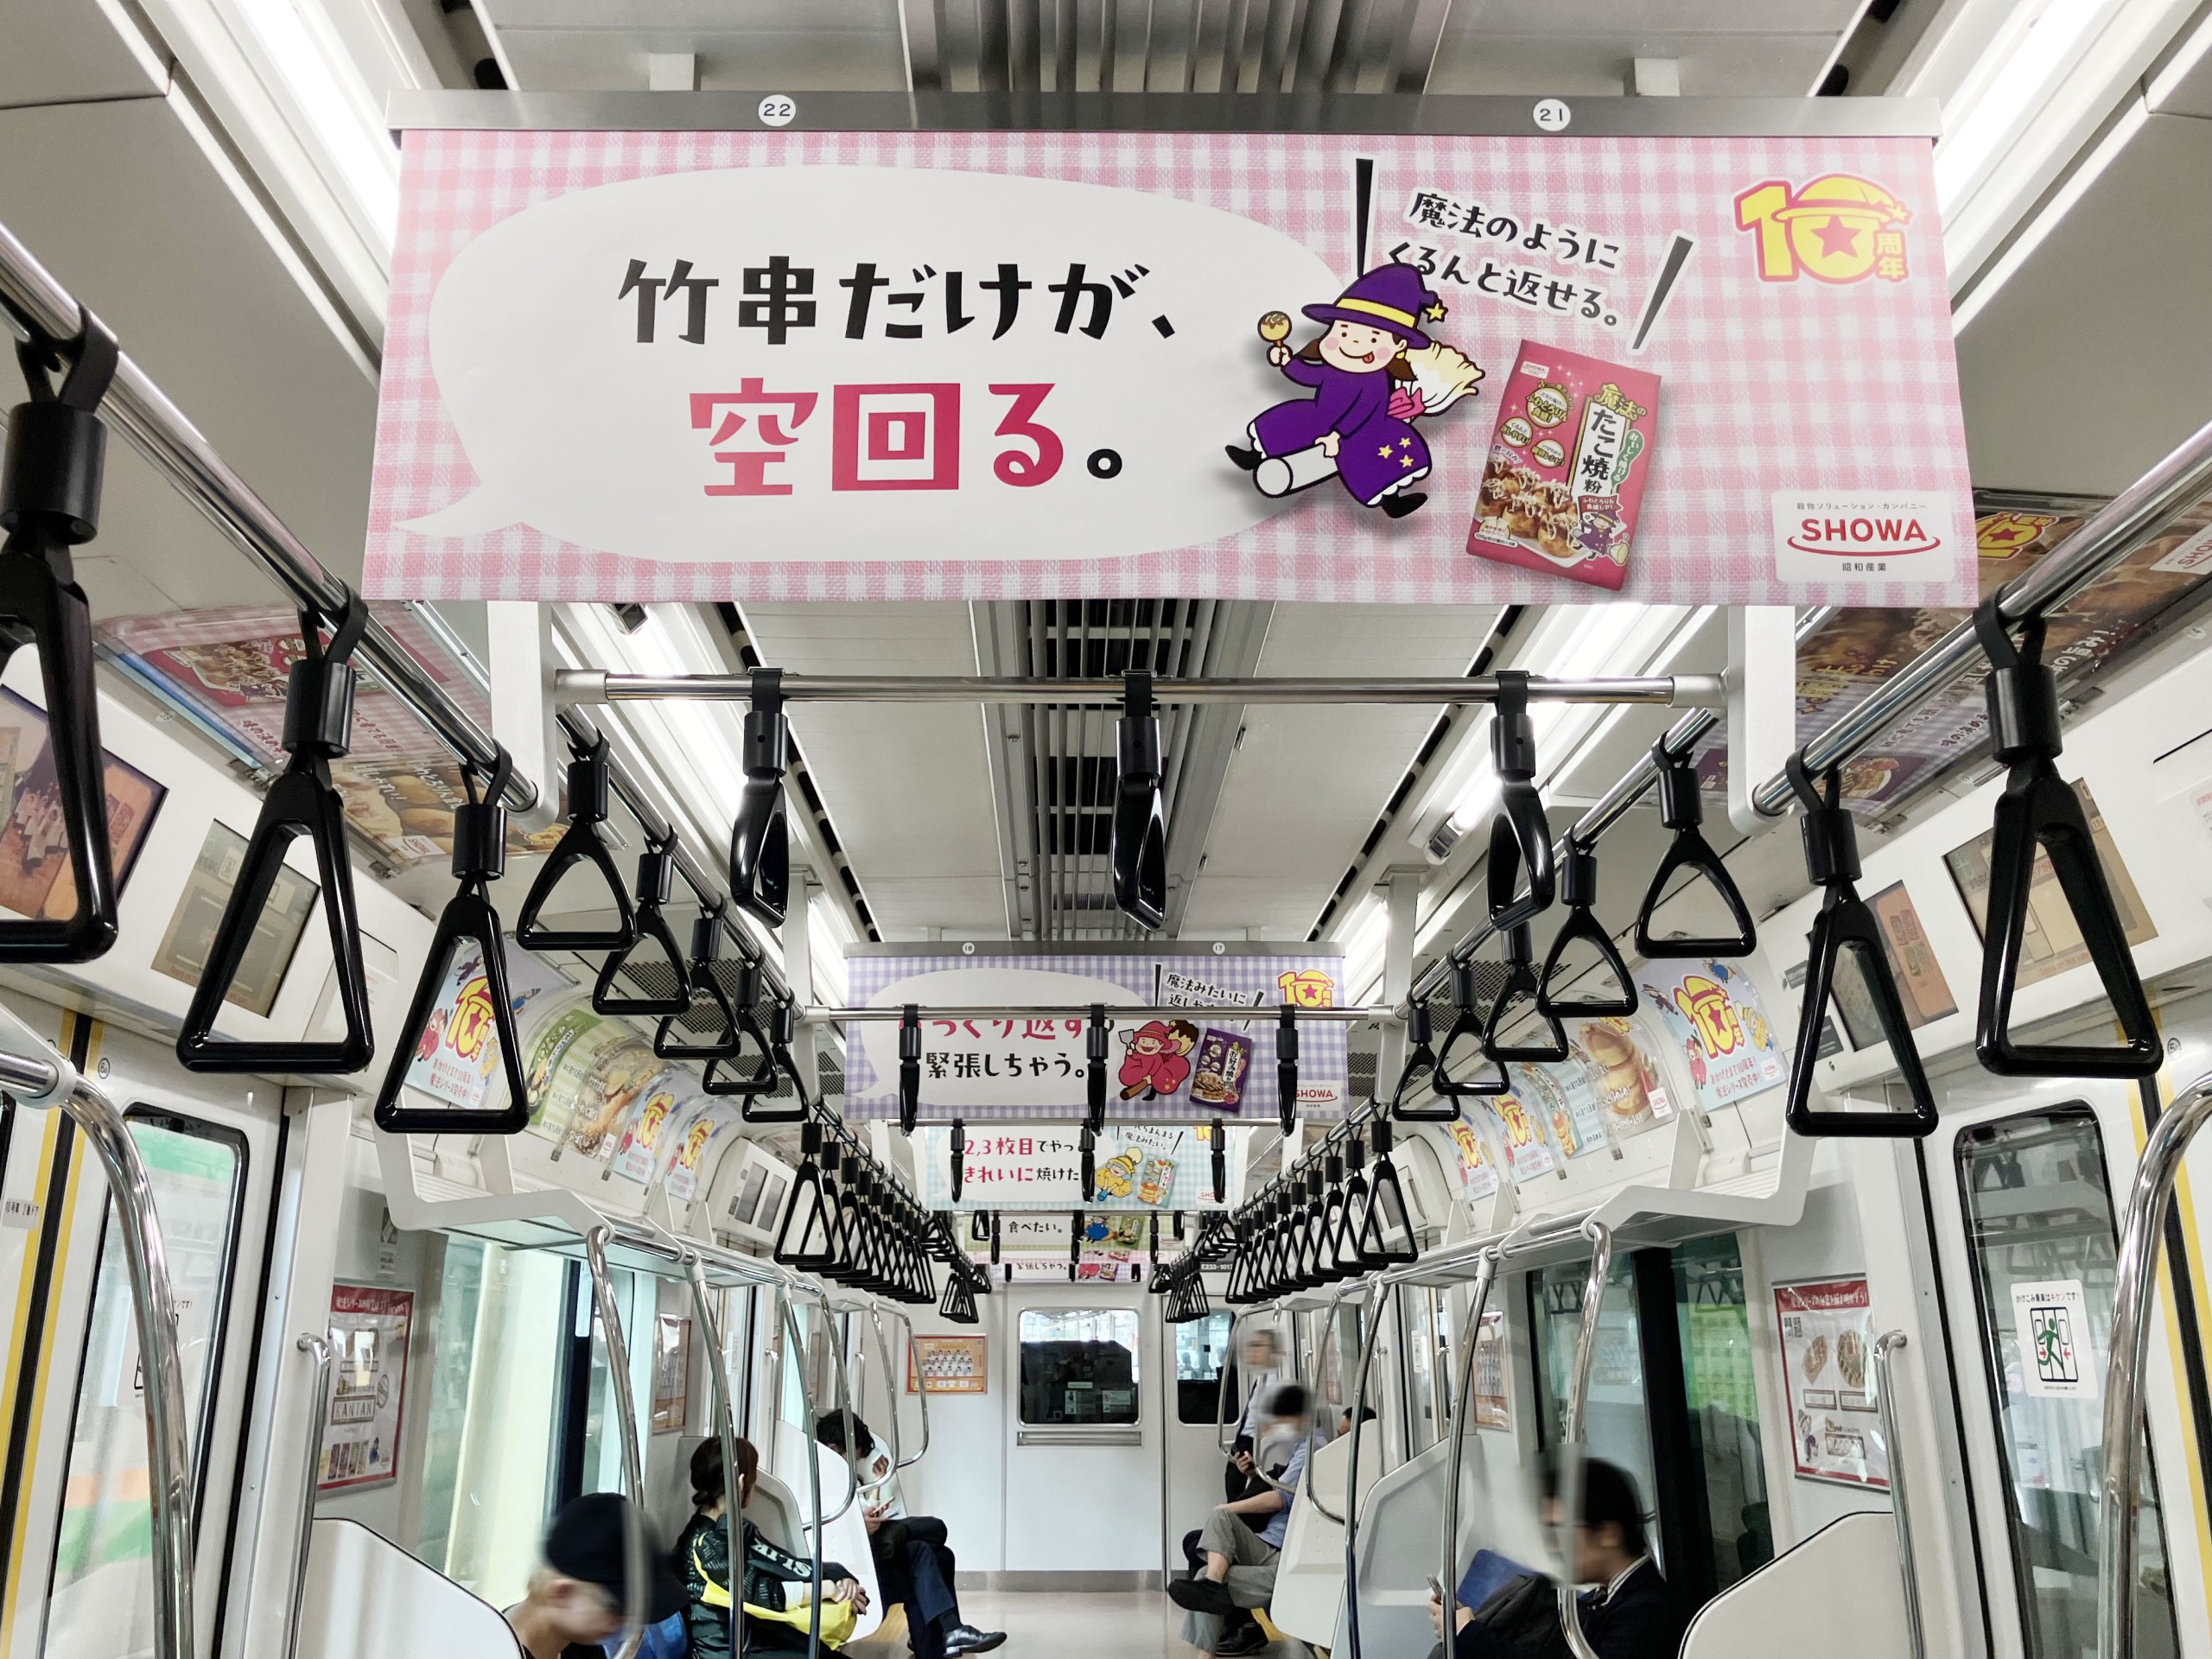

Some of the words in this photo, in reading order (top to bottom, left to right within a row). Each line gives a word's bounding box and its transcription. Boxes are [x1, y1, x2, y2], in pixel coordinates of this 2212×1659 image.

[764, 103, 791, 117] 22
[1540, 108, 1563, 122] 21
[1409, 193, 1620, 269] 魔法のように
[1388, 242, 1618, 326] くるんと返せる。
[618, 256, 1176, 345] 竹串だけが、
[689, 378, 1123, 496] 空回る。
[1802, 518, 1928, 543] SHOWA
[1842, 563, 1886, 572] 昭和産業
[1167, 974, 1246, 1004] 魔法みたいに
[926, 1052, 1084, 1079] 緊張しちゃう。
[1295, 1089, 1333, 1098] SHOWA
[964, 1137, 1081, 1156] 2,3枚目でやっ
[964, 1166, 1079, 1183] きれいに焼けた
[1008, 1221, 1063, 1234] 食べたい。
